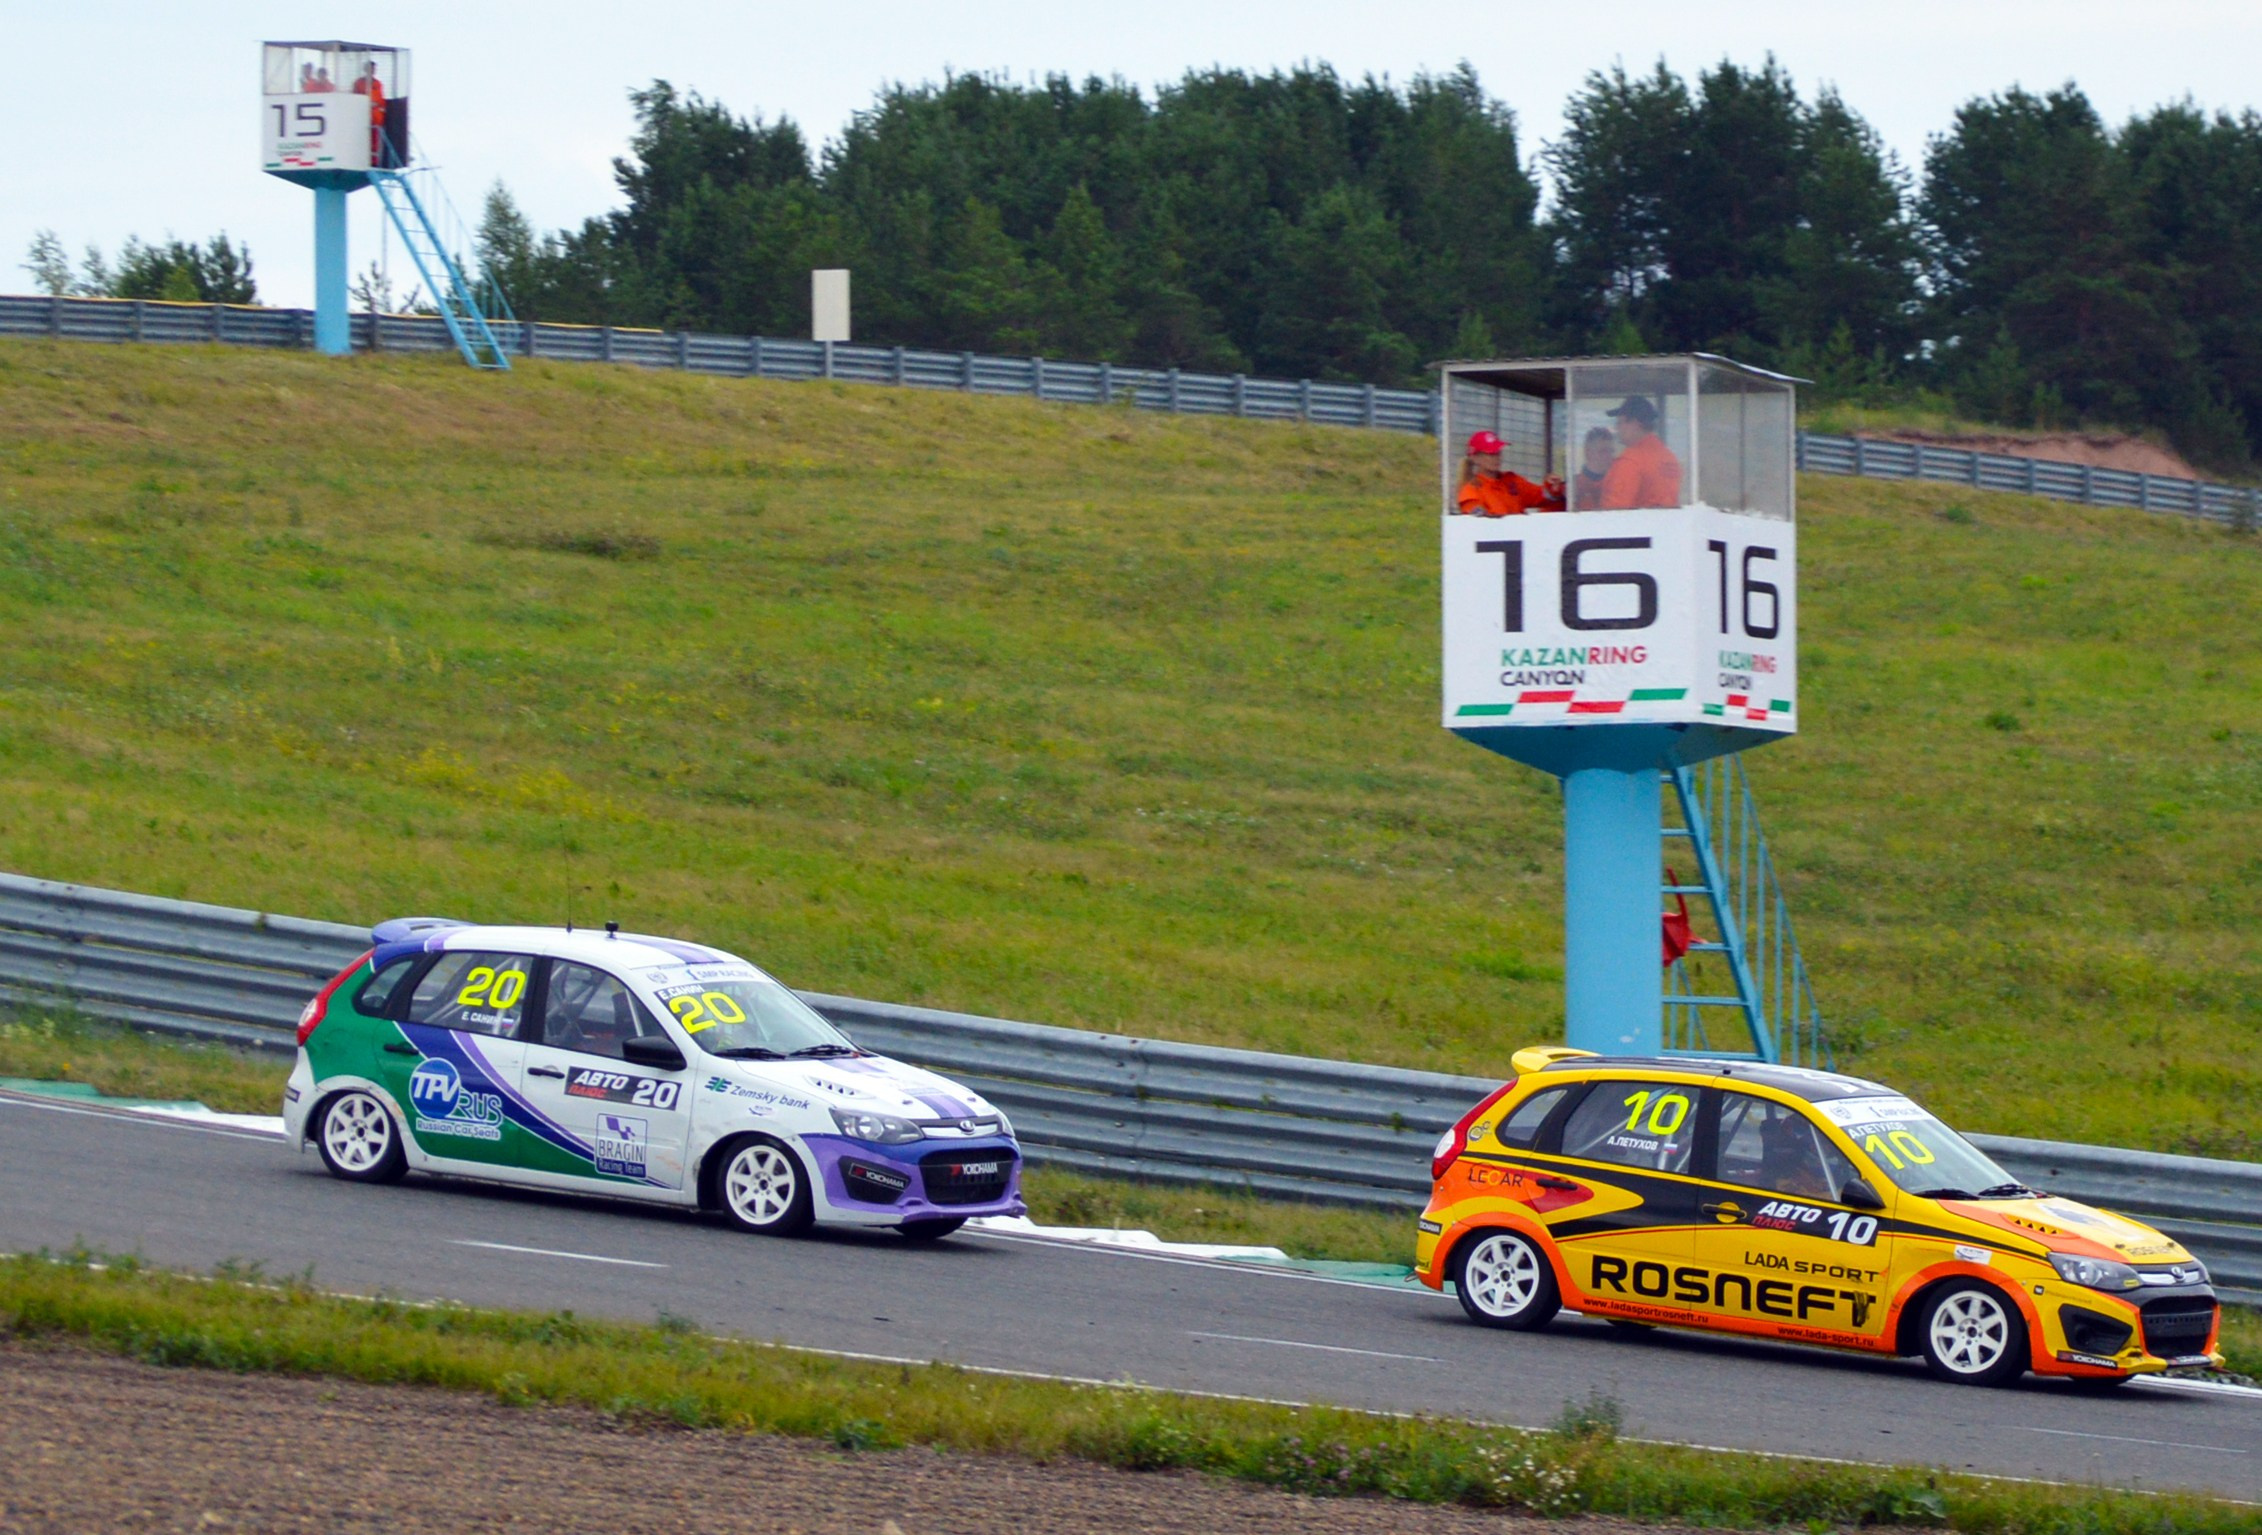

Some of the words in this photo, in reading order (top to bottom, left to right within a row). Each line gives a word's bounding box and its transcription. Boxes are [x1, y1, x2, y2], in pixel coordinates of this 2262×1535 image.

[271, 103, 326, 137] 15
[1475, 537, 1658, 633] 16
[1707, 538, 1780, 640] 16
[1501, 645, 1647, 668] KAZANRING
[1500, 669, 1585, 687] CANYON
[457, 966, 526, 1010] 20
[668, 991, 747, 1034] 20
[412, 1071, 461, 1102] TPV
[631, 1079, 678, 1109] 20
[730, 1085, 778, 1105] Zemsky
[779, 1095, 810, 1110] bank
[1623, 1088, 1690, 1135] 10
[417, 1119, 453, 1132] Russian
[454, 1123, 472, 1135] Car
[473, 1126, 500, 1139] Seats
[1865, 1130, 1936, 1170] 10
[599, 1159, 623, 1175] Racing
[625, 1163, 644, 1175] Team
[865, 1169, 905, 1188] YOKOHAMA
[962, 1162, 998, 1175] YOKOHAMA
[1468, 1167, 1524, 1188] LECAR
[1827, 1212, 1878, 1245] 10
[1744, 1250, 1790, 1271] LADA
[1793, 1260, 1880, 1283] SPORT
[1591, 1254, 1877, 1328] ROSNEFT
[1583, 1297, 1709, 1324] www.ladasportrosneft.ru
[1777, 1325, 1875, 1348] www.lada-sport.ru
[2072, 1353, 2117, 1368] YOKOHAMA
